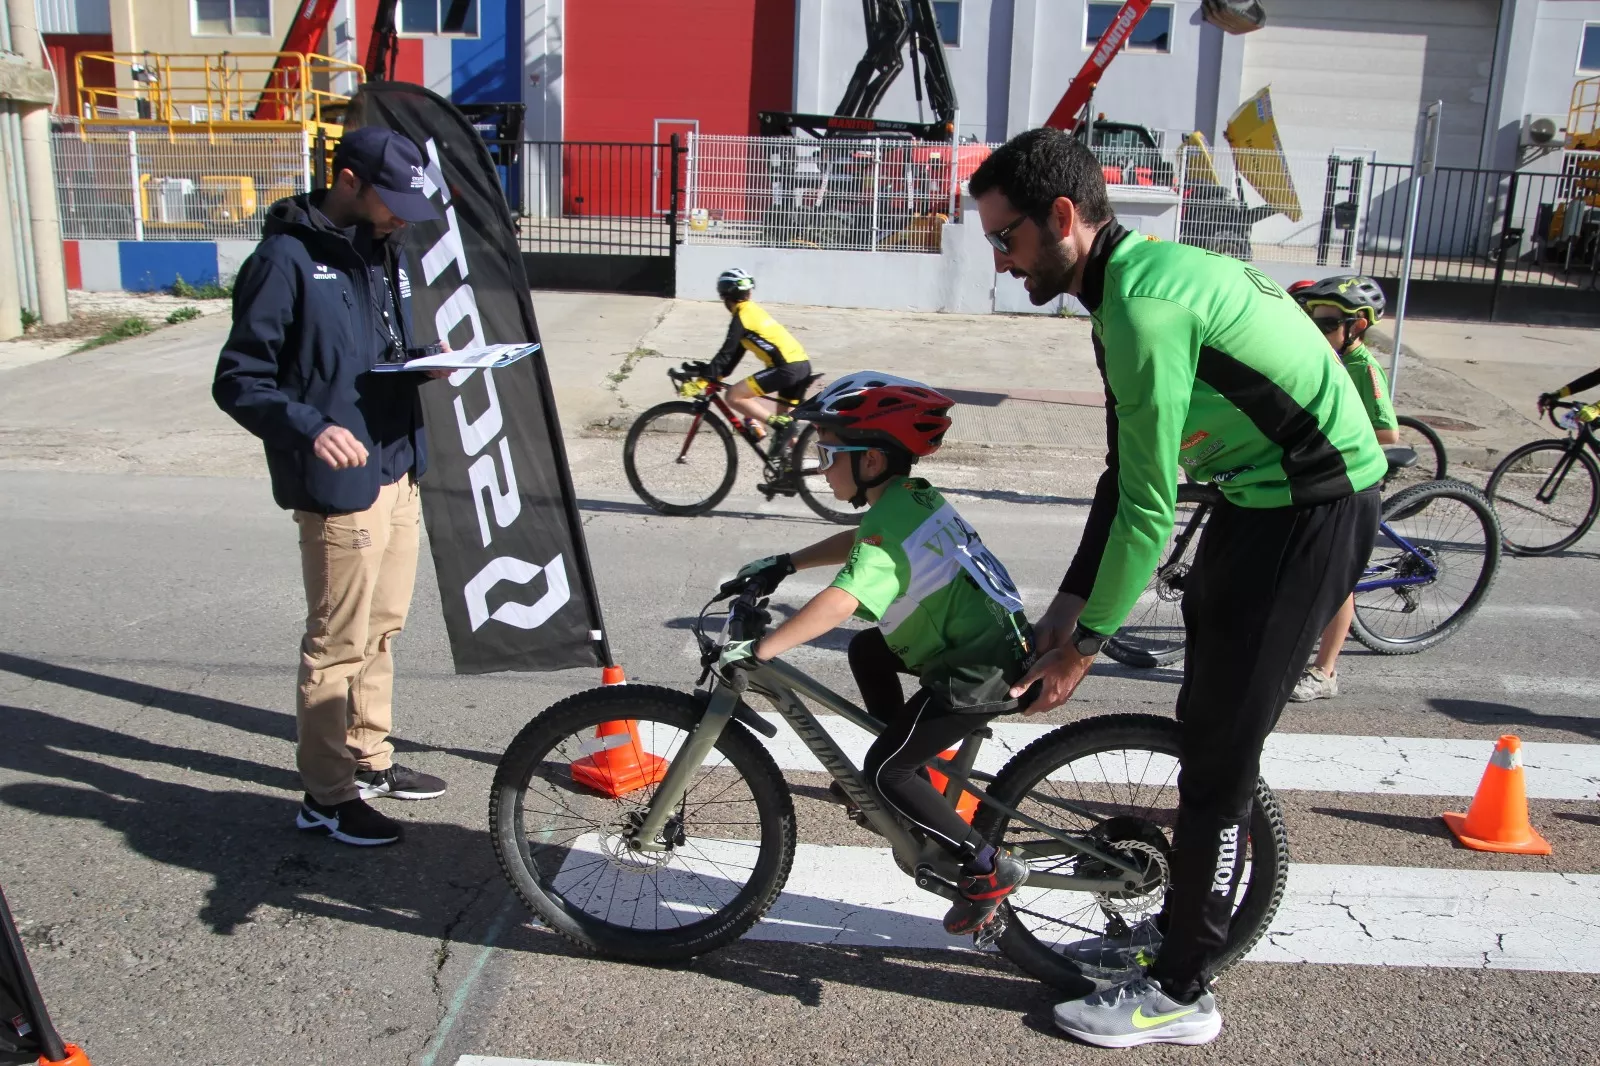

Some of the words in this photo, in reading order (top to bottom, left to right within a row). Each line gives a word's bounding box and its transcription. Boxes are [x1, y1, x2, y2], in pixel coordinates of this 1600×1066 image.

[1093, 6, 1136, 67] MANITOU
[827, 118, 875, 130] MANITOU
[782, 703, 880, 811] SPECIALIZED
[704, 919, 736, 940] CONTROL
